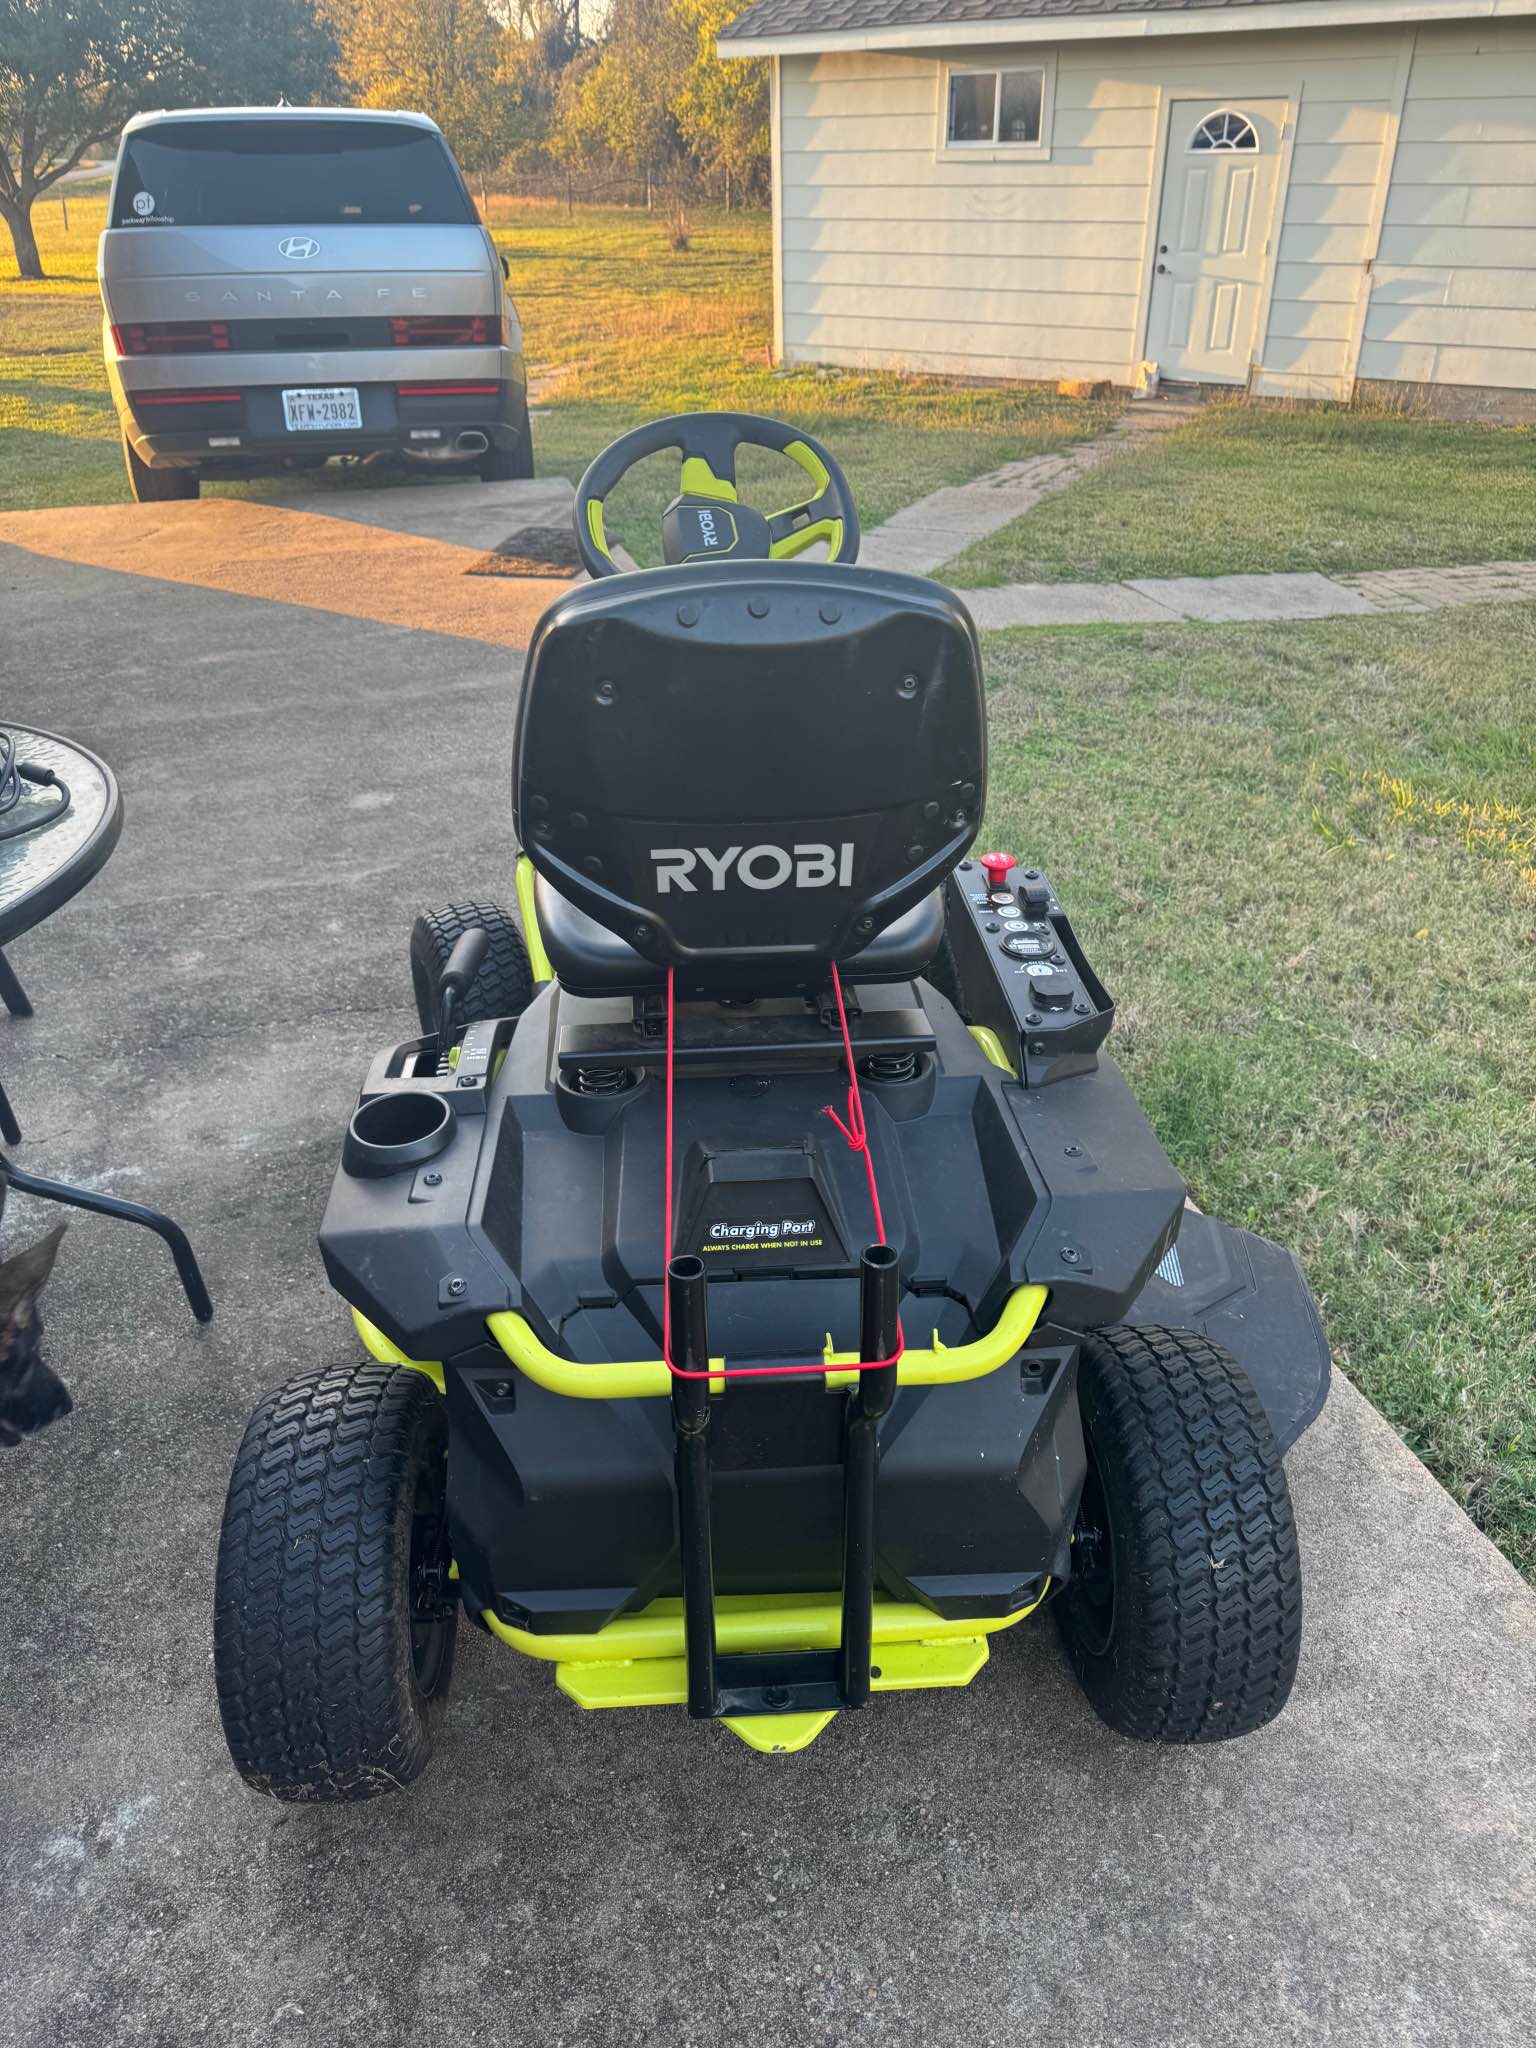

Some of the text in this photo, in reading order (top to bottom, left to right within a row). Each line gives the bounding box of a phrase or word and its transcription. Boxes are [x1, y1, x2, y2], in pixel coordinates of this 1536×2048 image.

[184, 287, 426, 302] SANTA FE
[308, 392, 335, 400] TEXAS
[697, 509, 718, 547] RYOBI
[650, 842, 855, 894] RYOBI
[710, 1220, 815, 1239] Charging Port
[702, 1244, 730, 1252] ALWAYS
[731, 1243, 759, 1251] CHARGE
[760, 1241, 782, 1249] WHEN
[783, 1240, 799, 1248] NOT
